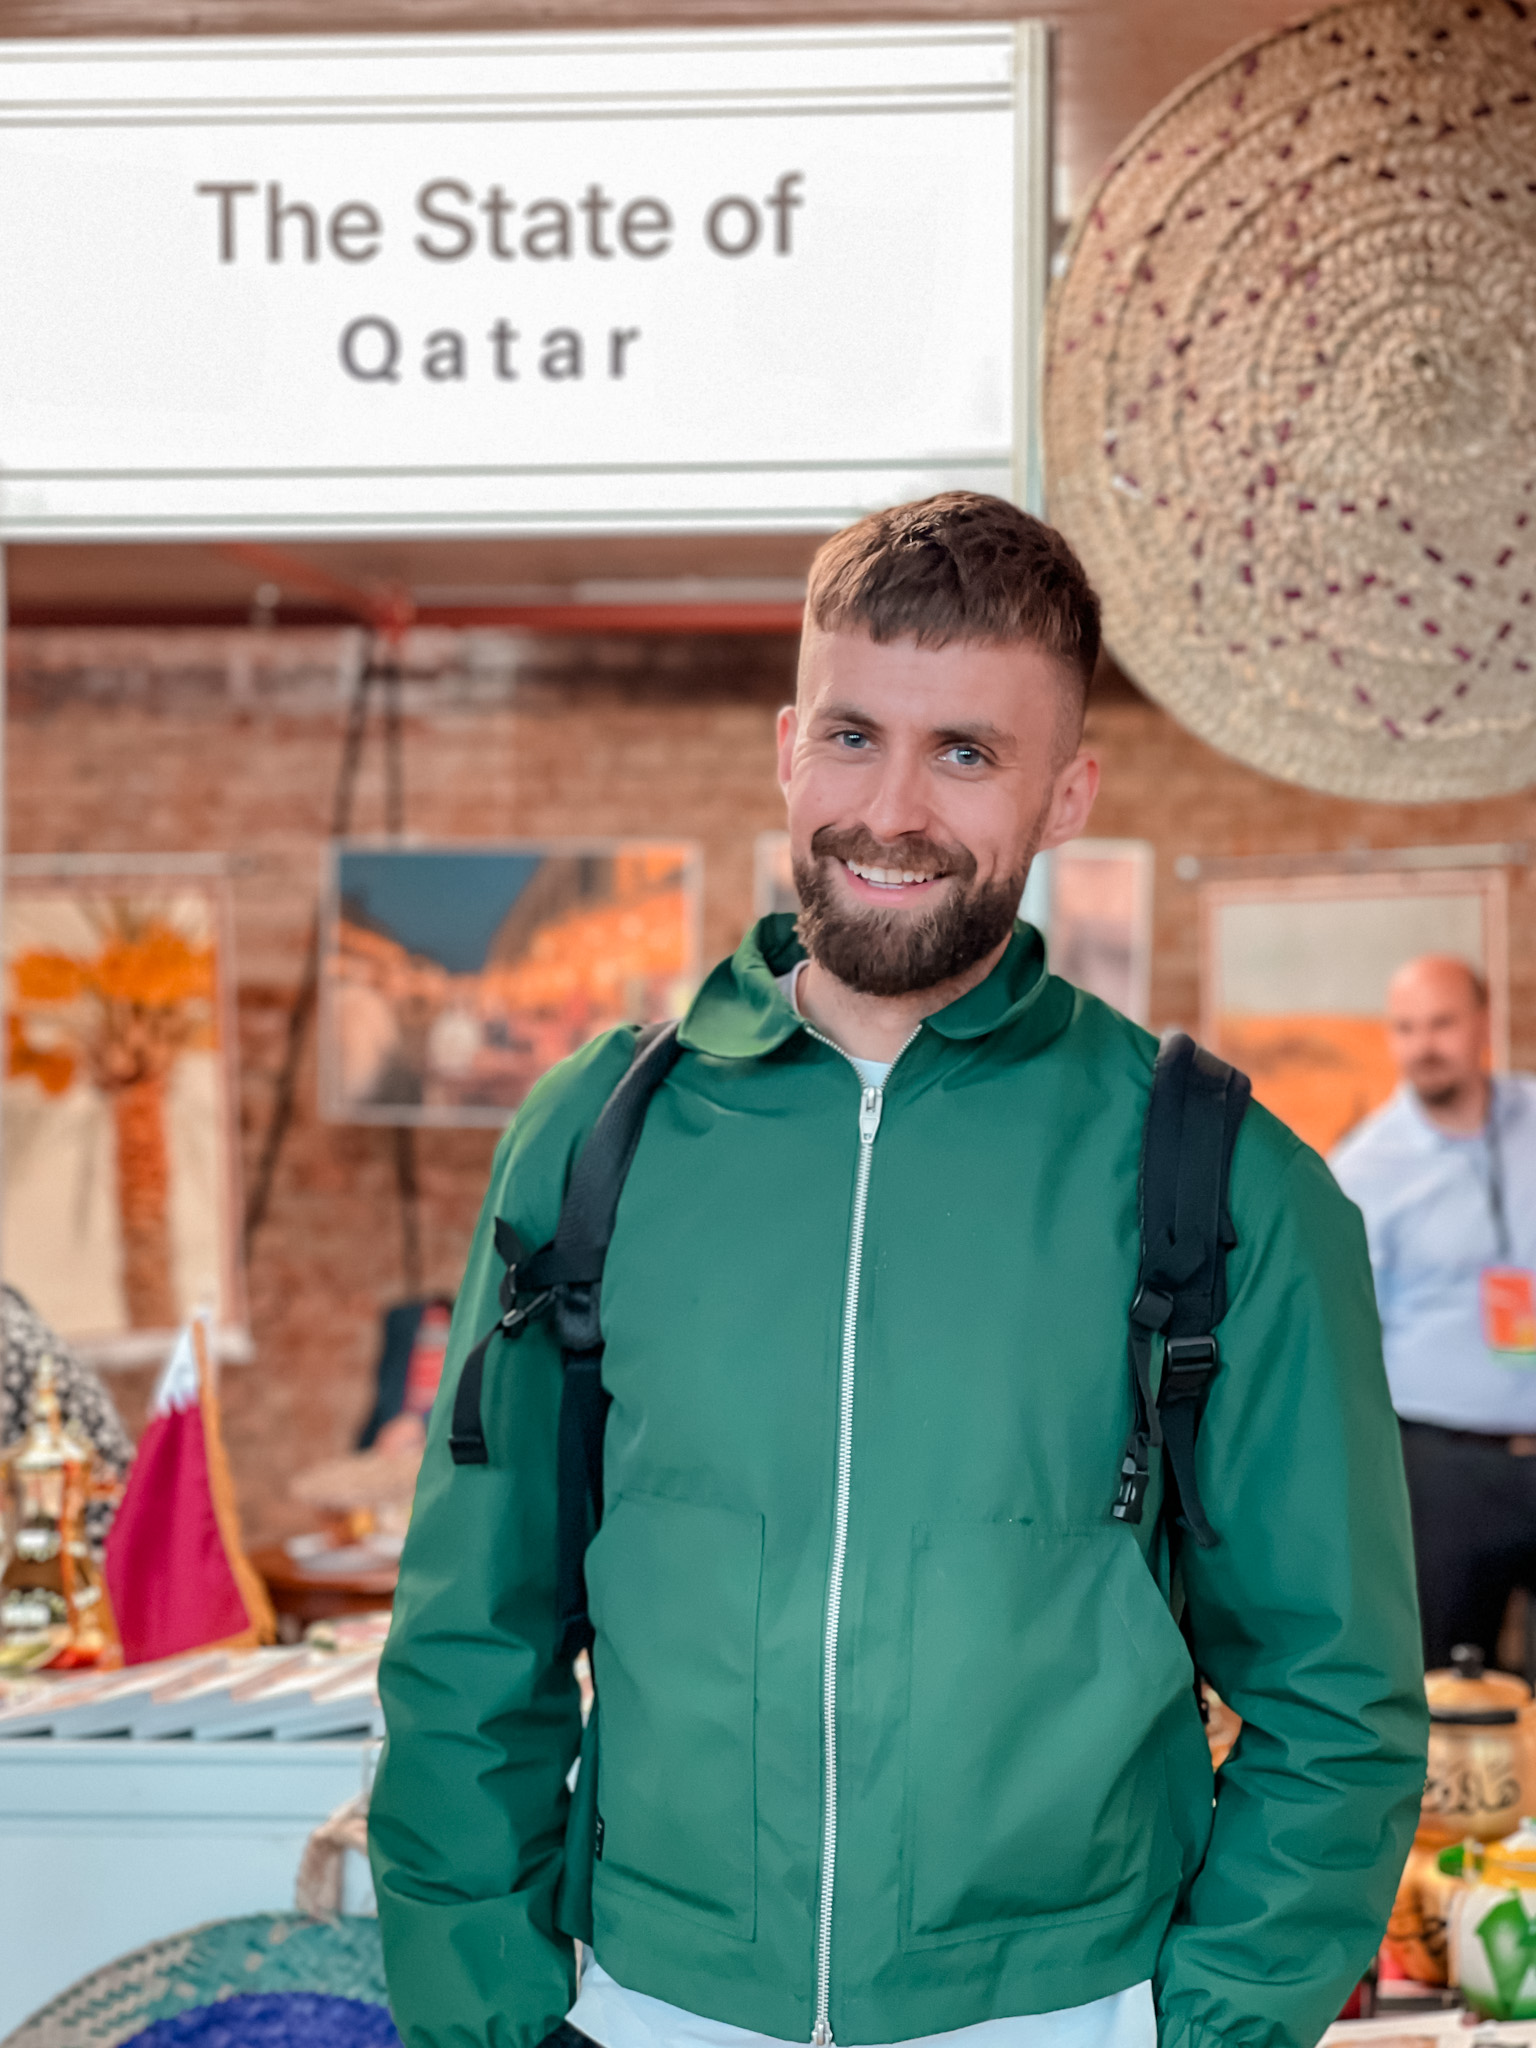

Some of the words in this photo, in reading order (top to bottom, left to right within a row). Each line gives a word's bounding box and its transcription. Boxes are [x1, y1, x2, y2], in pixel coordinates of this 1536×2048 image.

[196, 182, 383, 263] The
[415, 178, 673, 262] State
[705, 171, 803, 258] of
[339, 315, 640, 382] Qatar
